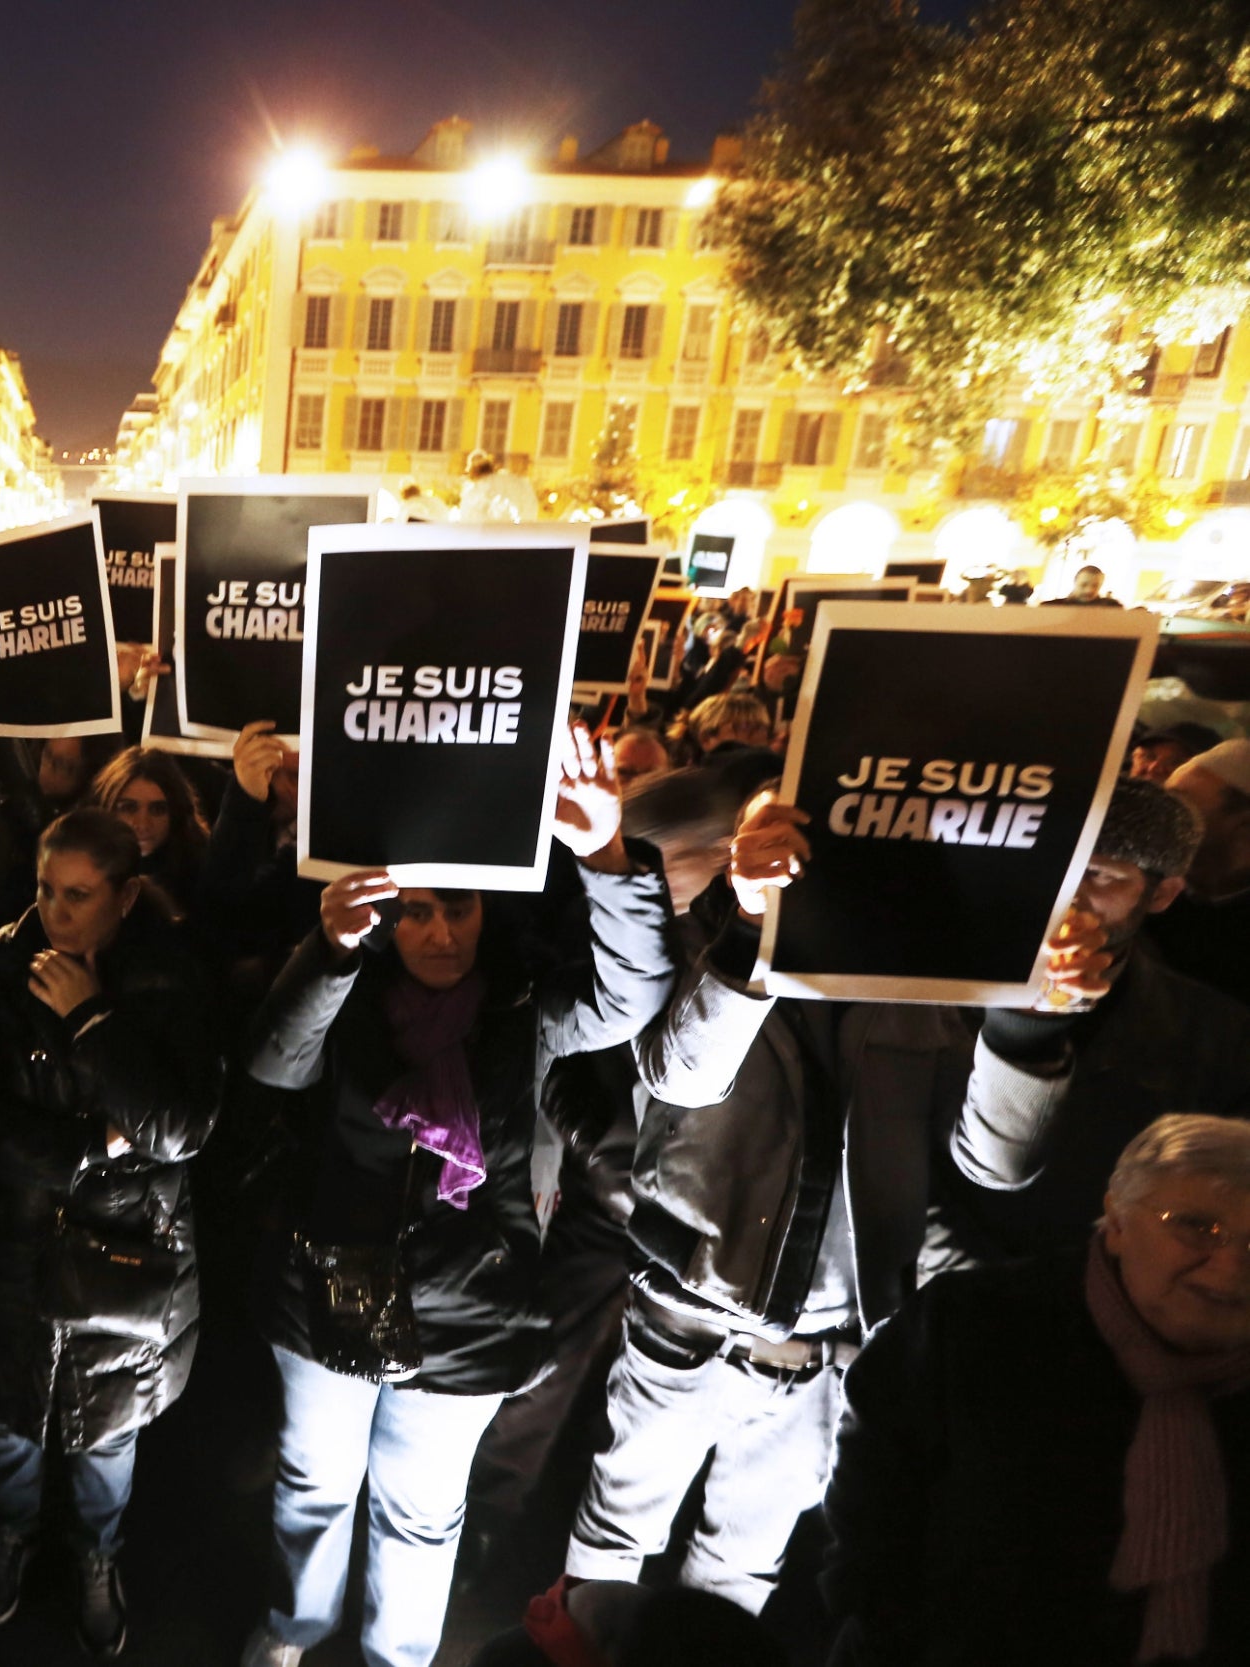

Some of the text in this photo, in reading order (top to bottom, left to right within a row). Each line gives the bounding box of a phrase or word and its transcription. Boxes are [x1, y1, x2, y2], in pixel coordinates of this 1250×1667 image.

[104, 549, 127, 567] JE
[206, 580, 249, 606] JE
[583, 600, 631, 614] SUIS
[20, 595, 83, 626] SUIS
[345, 665, 524, 700] JE SUIS
[343, 698, 523, 745] CHARLIE
[836, 755, 1056, 800] JE SUIS
[828, 792, 1049, 850] CHARLIE
